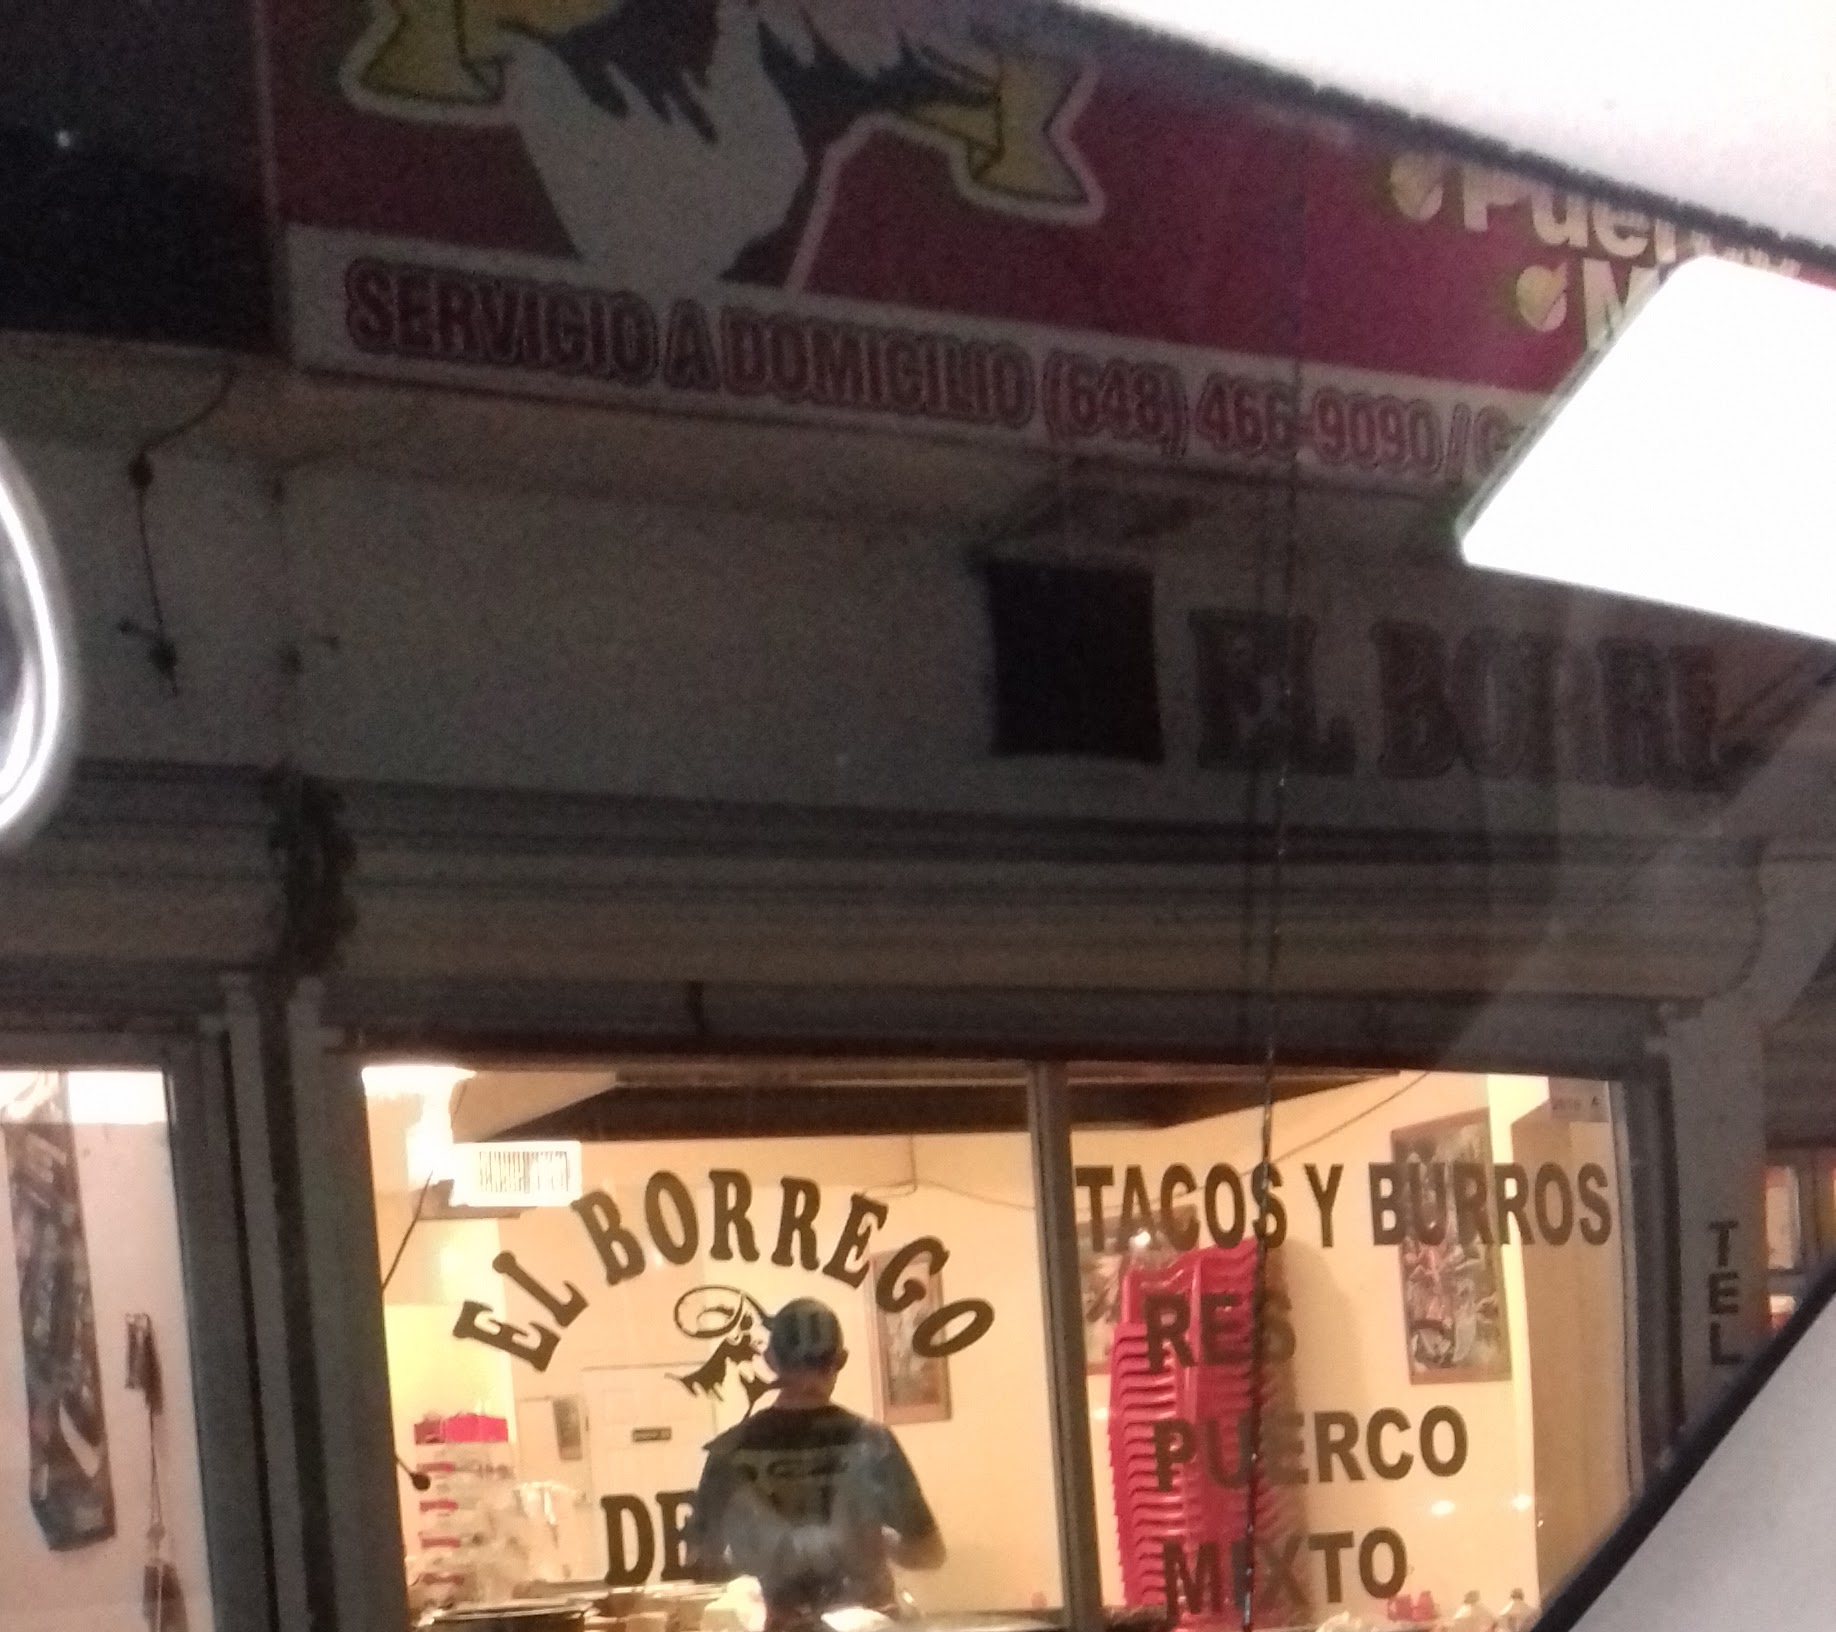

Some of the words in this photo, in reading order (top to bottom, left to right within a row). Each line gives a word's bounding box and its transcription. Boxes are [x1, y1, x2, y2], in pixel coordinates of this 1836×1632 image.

[663, 298, 721, 390] A
[721, 304, 1035, 430] DOMICILIO
[1074, 1162, 1287, 1249] TACOS
[1304, 1162, 1343, 1248] Y
[1368, 1161, 1613, 1248] BURROS
[453, 1249, 590, 1373] EL
[571, 1168, 995, 1358] BORREGO
[1708, 1220, 1743, 1366] TEL
[1144, 1293, 1297, 1375] RES
[1152, 1404, 1469, 1493] PUERCO
[1162, 1526, 1407, 1629] MIXTO
